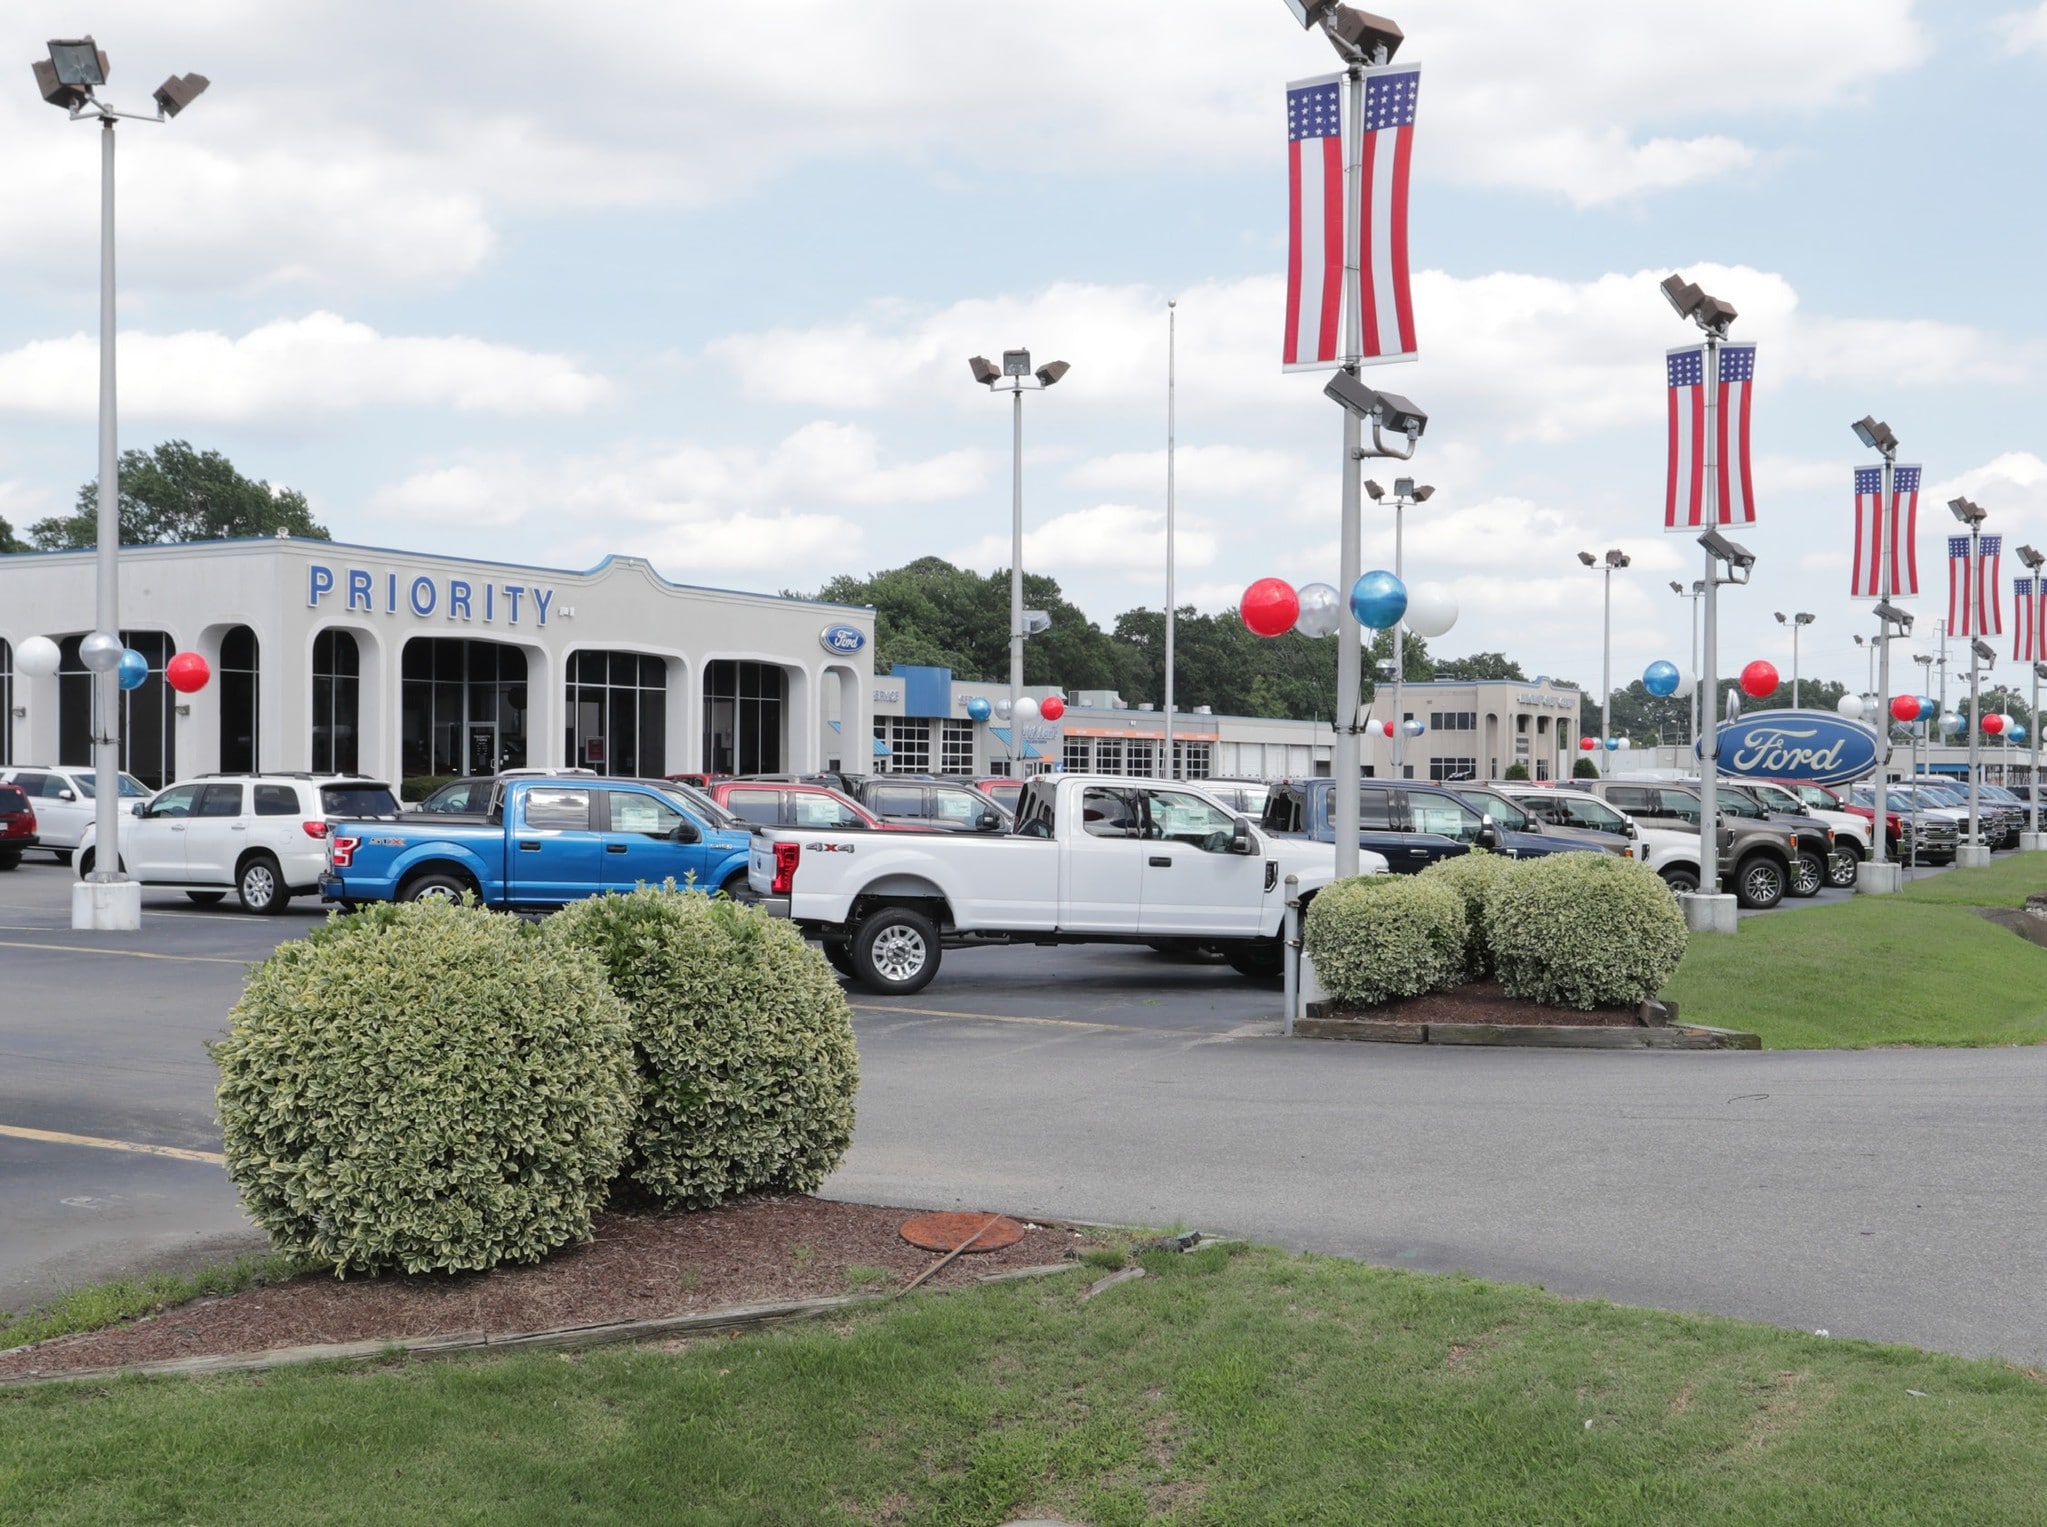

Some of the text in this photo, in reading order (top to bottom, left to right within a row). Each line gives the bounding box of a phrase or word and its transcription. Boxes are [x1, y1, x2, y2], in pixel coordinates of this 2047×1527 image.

[308, 563, 554, 627] PRIORITY
[834, 629, 860, 648] Ford
[1733, 728, 1846, 771] Ford
